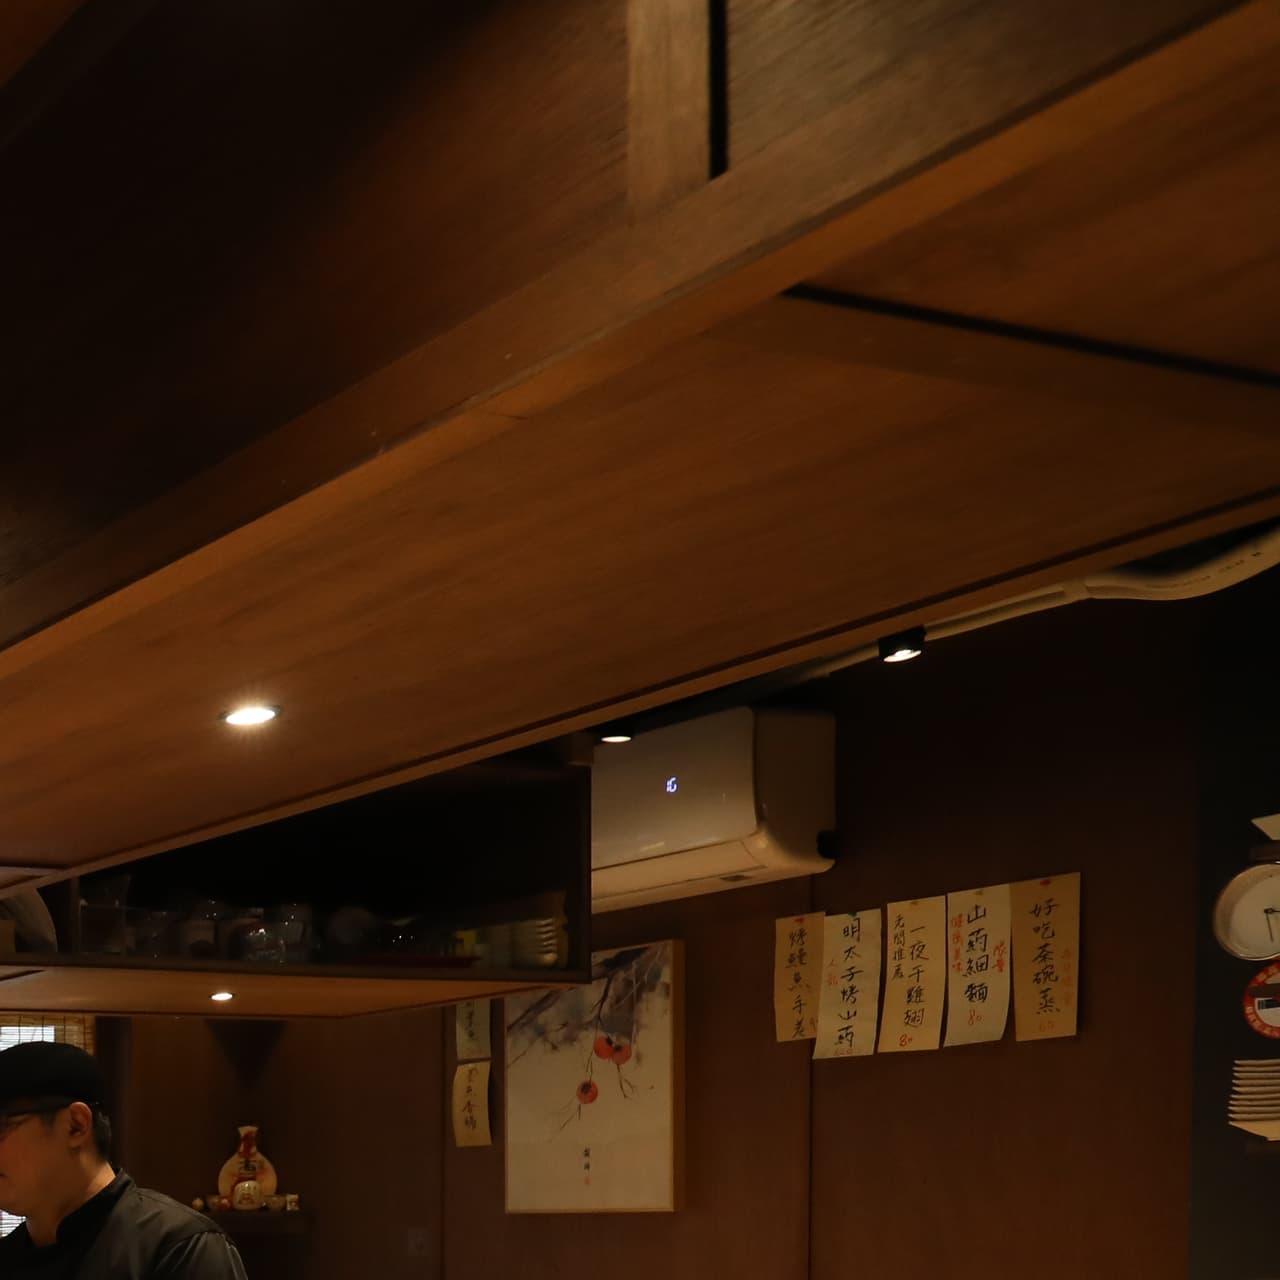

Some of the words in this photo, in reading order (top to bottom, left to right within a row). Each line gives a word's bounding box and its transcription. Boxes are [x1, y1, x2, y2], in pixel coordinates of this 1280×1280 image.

[1028, 897, 1062, 1016] 好吃茶碗蒸
